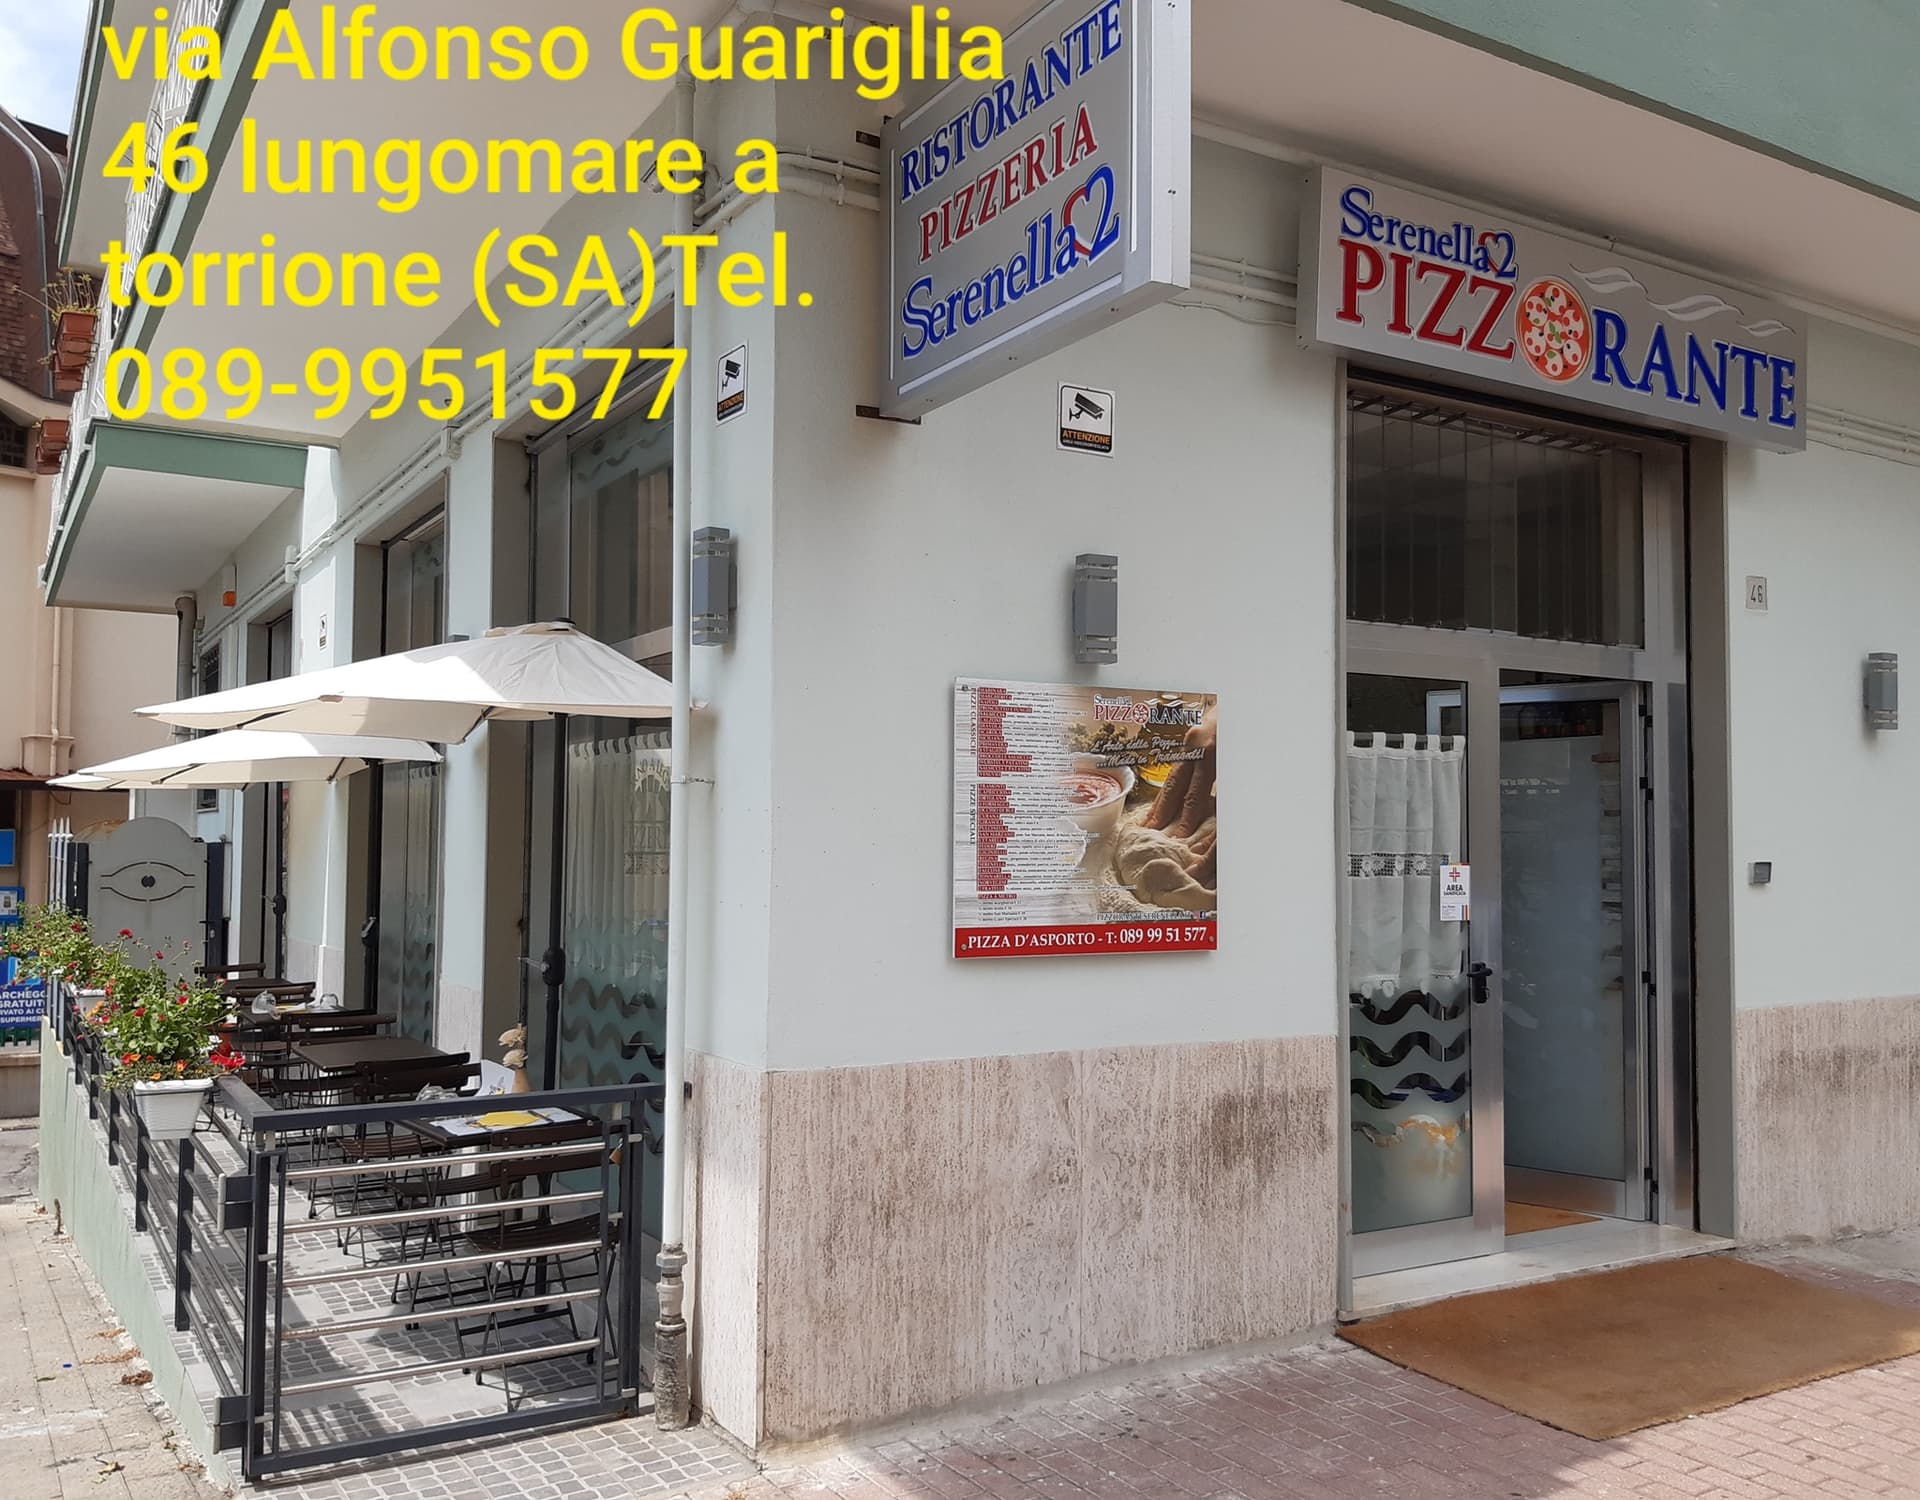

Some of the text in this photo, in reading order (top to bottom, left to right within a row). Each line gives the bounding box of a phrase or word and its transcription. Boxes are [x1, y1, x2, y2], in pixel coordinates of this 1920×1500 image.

[901, 0, 1122, 200] RISTORANTE
[919, 105, 1098, 263] PIZZERIA
[1062, 430, 1111, 445] ATTENZIONE
[1750, 584, 1763, 603] 46
[967, 934, 1011, 950] PIZZA
[1015, 931, 1095, 948] D'ASPORTO
[1105, 931, 1118, 944] T:
[1119, 928, 1143, 944] 089
[1146, 927, 1163, 943] 99
[1165, 927, 1181, 942] 51
[1184, 926, 1208, 942] 577
